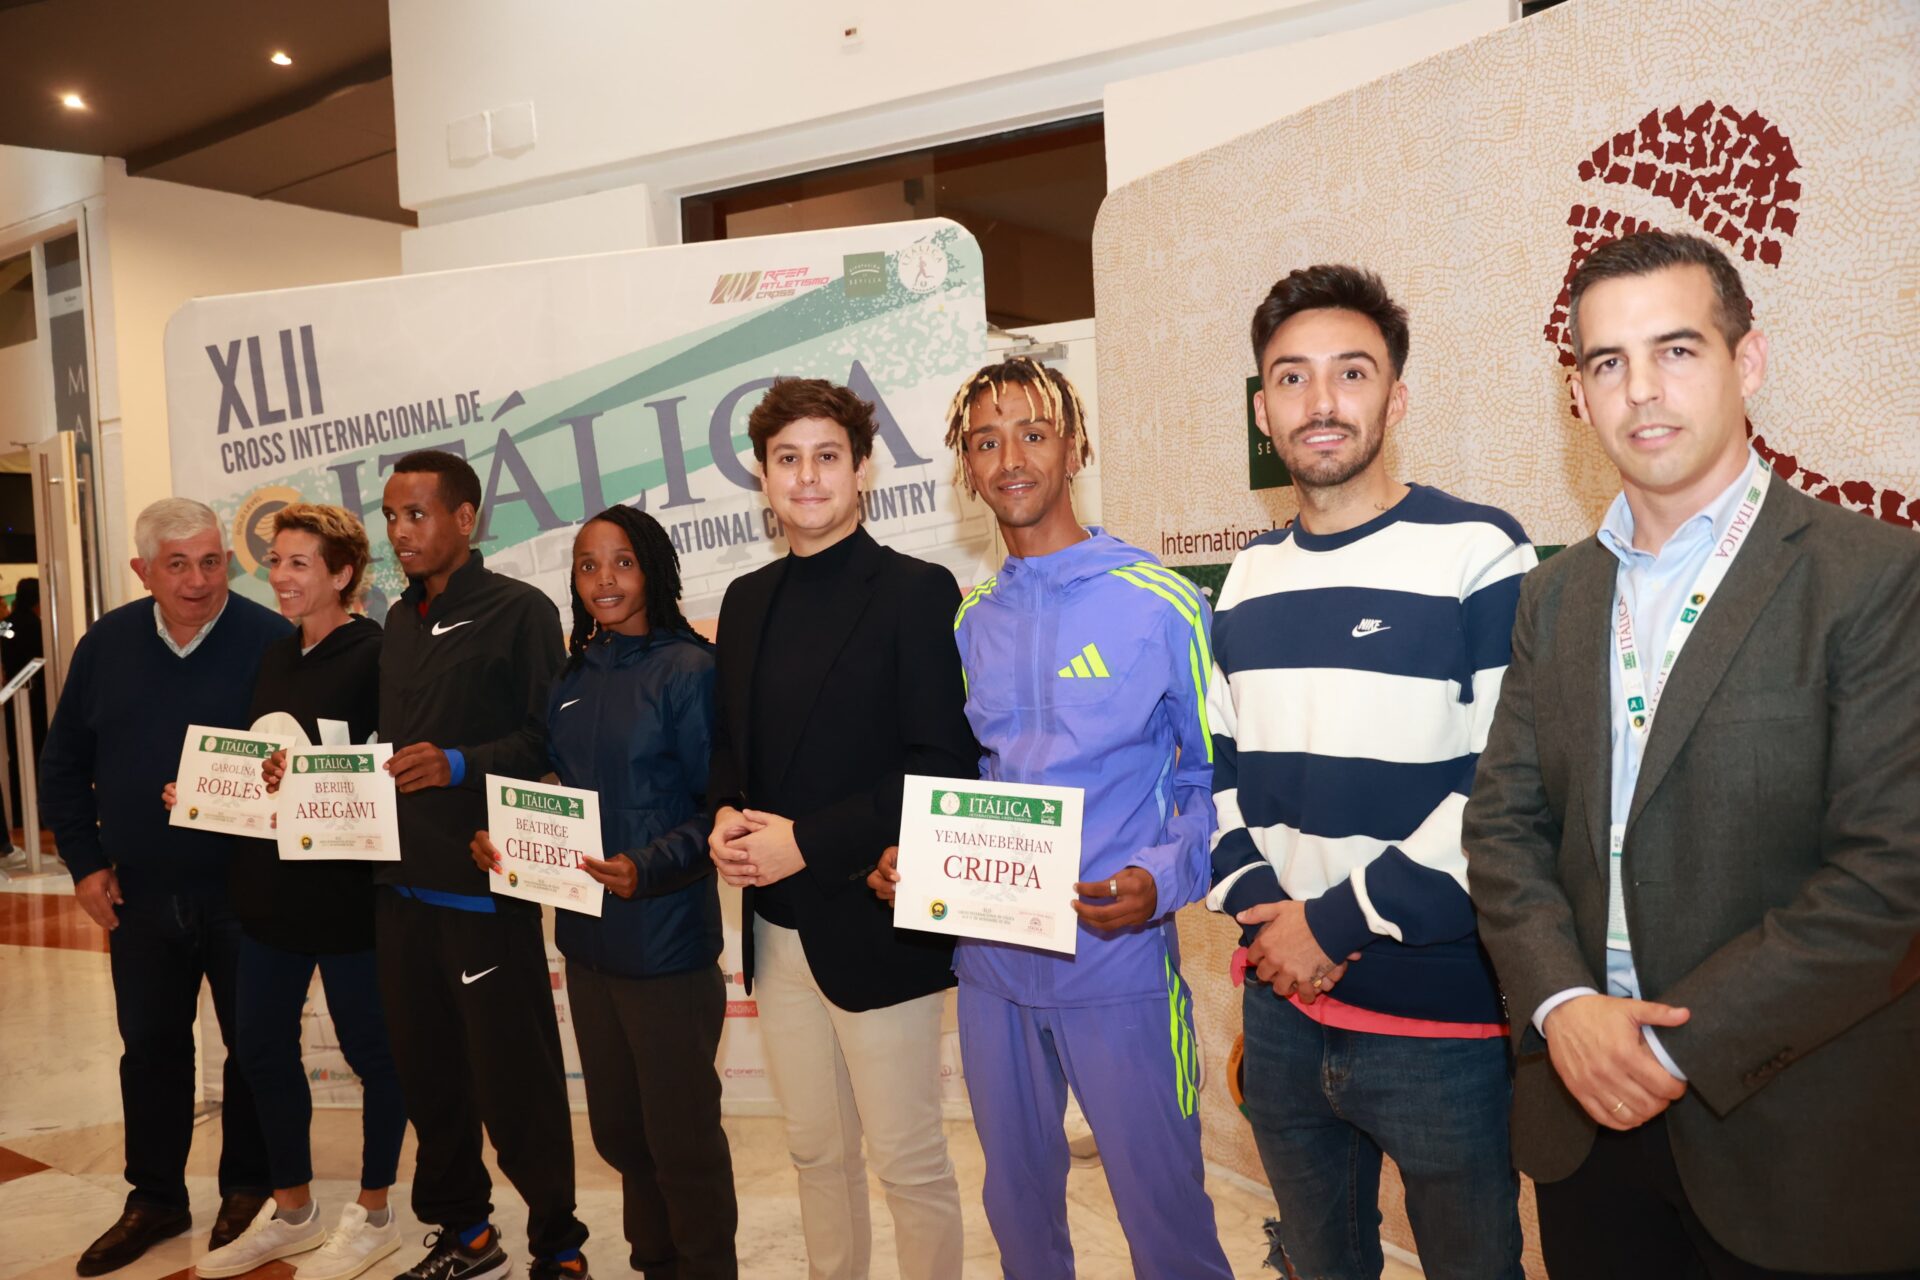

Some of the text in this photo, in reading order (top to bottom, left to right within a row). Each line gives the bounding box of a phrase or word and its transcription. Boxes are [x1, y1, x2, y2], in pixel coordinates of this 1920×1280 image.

[764, 266, 809, 281] RFEA
[756, 288, 796, 300] CROSS
[760, 277, 830, 291] ATLETISMO
[205, 324, 324, 435] XLII
[221, 389, 484, 474] CROSS INTERNACIONAL DE
[663, 511, 760, 555] ATIONAL
[1715, 503, 1755, 559] ITÁLICA
[1358, 618, 1382, 630] NIKE
[220, 736, 259, 755] ITÁLICA
[211, 762, 256, 777] CAROLINA
[314, 754, 352, 770] ITÁLICA
[196, 776, 263, 800] ROBLES
[315, 781, 354, 794] BERIHU
[296, 801, 376, 819] AREGAWI
[521, 792, 562, 811] ITÁLICA
[969, 795, 1032, 818] ITÁLICA
[516, 817, 569, 839] BEATRICE
[935, 829, 1053, 855] YEMANEBERHAN
[506, 837, 583, 870] CHEBET
[943, 855, 1042, 889] CRIPPA
